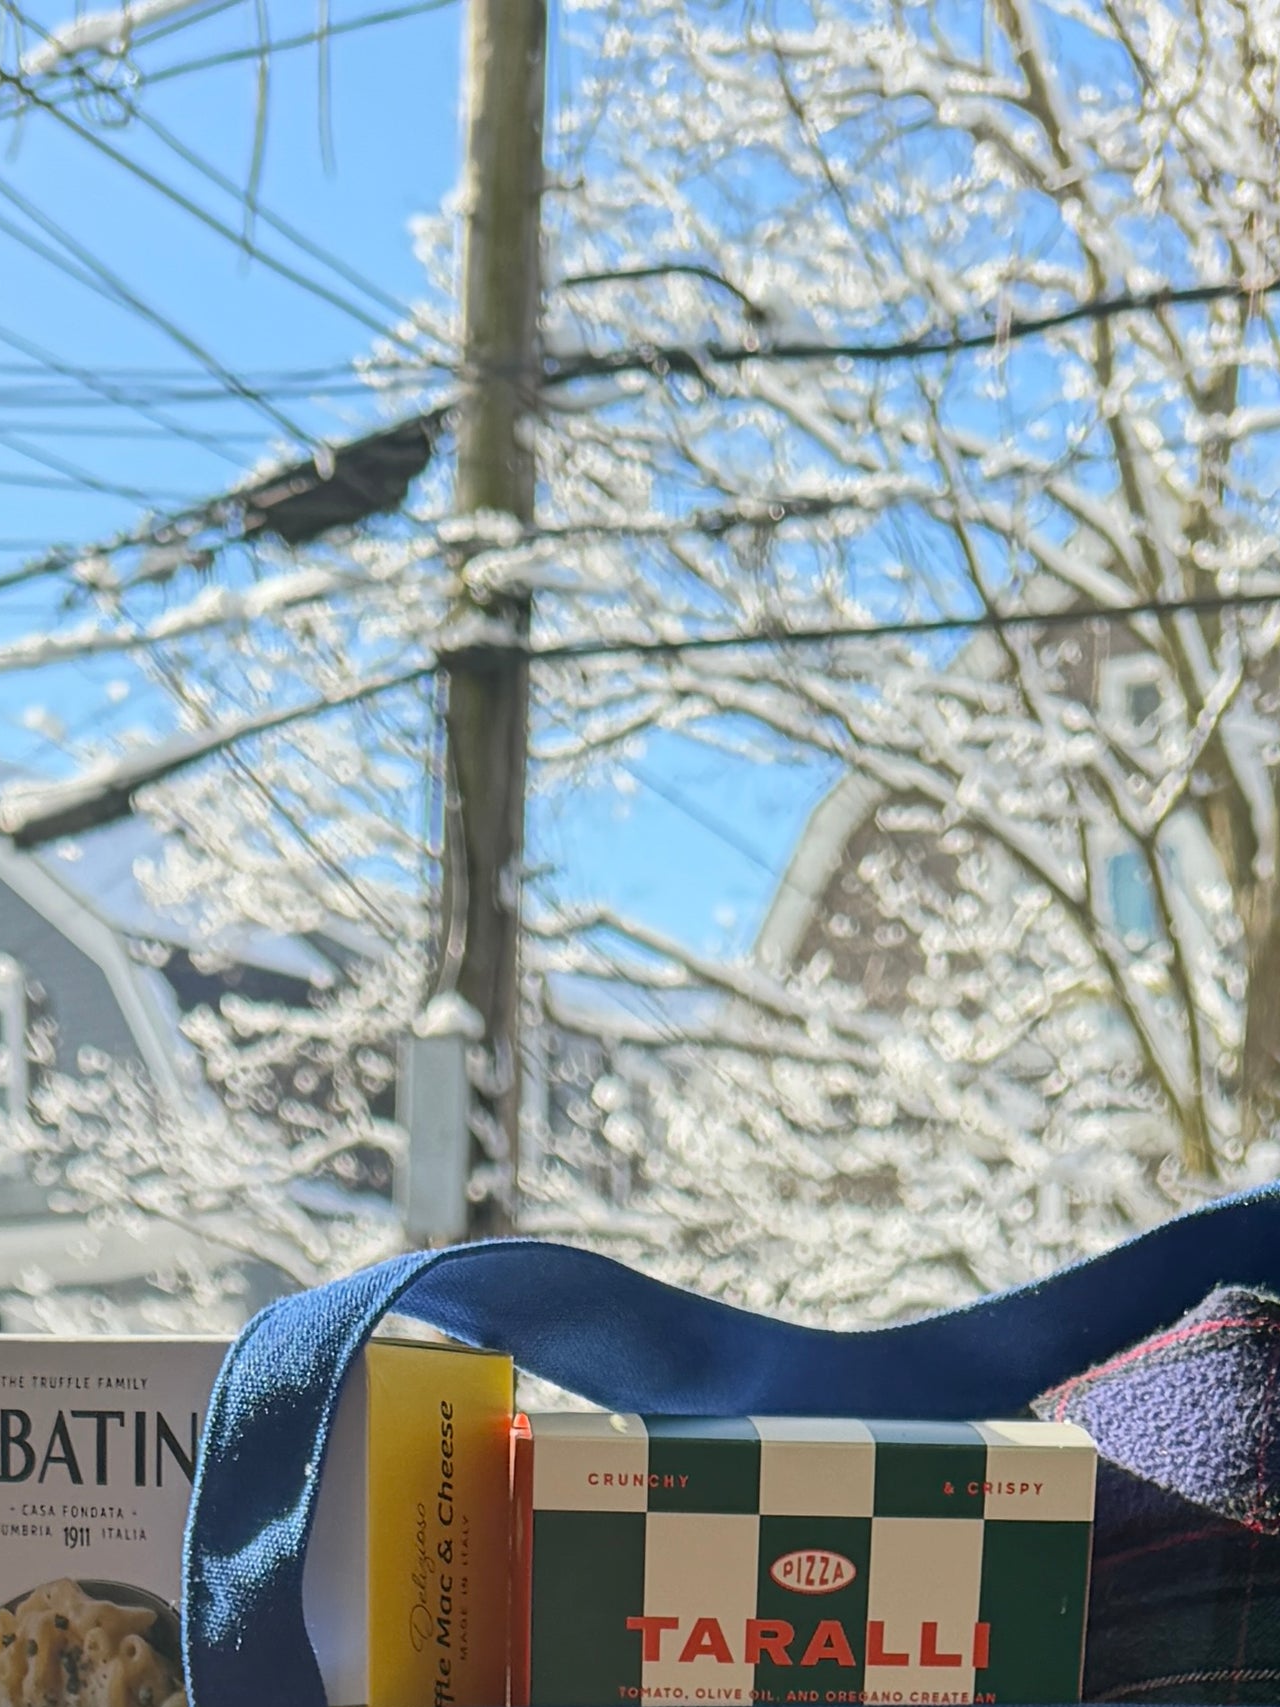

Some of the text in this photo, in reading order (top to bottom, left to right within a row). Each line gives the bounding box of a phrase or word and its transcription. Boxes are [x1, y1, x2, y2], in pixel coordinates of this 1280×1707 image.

[1, 1376, 148, 1390] THE TRUFFLE FAMILY
[437, 1400, 454, 1527] Cheese
[588, 1473, 1045, 1496] CRUNCHY & CRISPY
[21, 1504, 124, 1519] CASA FONDATA
[1, 1524, 147, 1549] UMBRIA 1911 ITALIA
[437, 1540, 453, 1564] &
[783, 1555, 845, 1586] PIZZA
[435, 1573, 453, 1648] Mac
[626, 1616, 991, 1669] TARALLI
[619, 1686, 690, 1701] TOMATO,
[695, 1688, 743, 1700] OLIVE
[785, 1690, 819, 1702] AND
[826, 1690, 904, 1704] OREGANO
[909, 1692, 970, 1704] CREATE
[975, 1692, 996, 1704] AN
